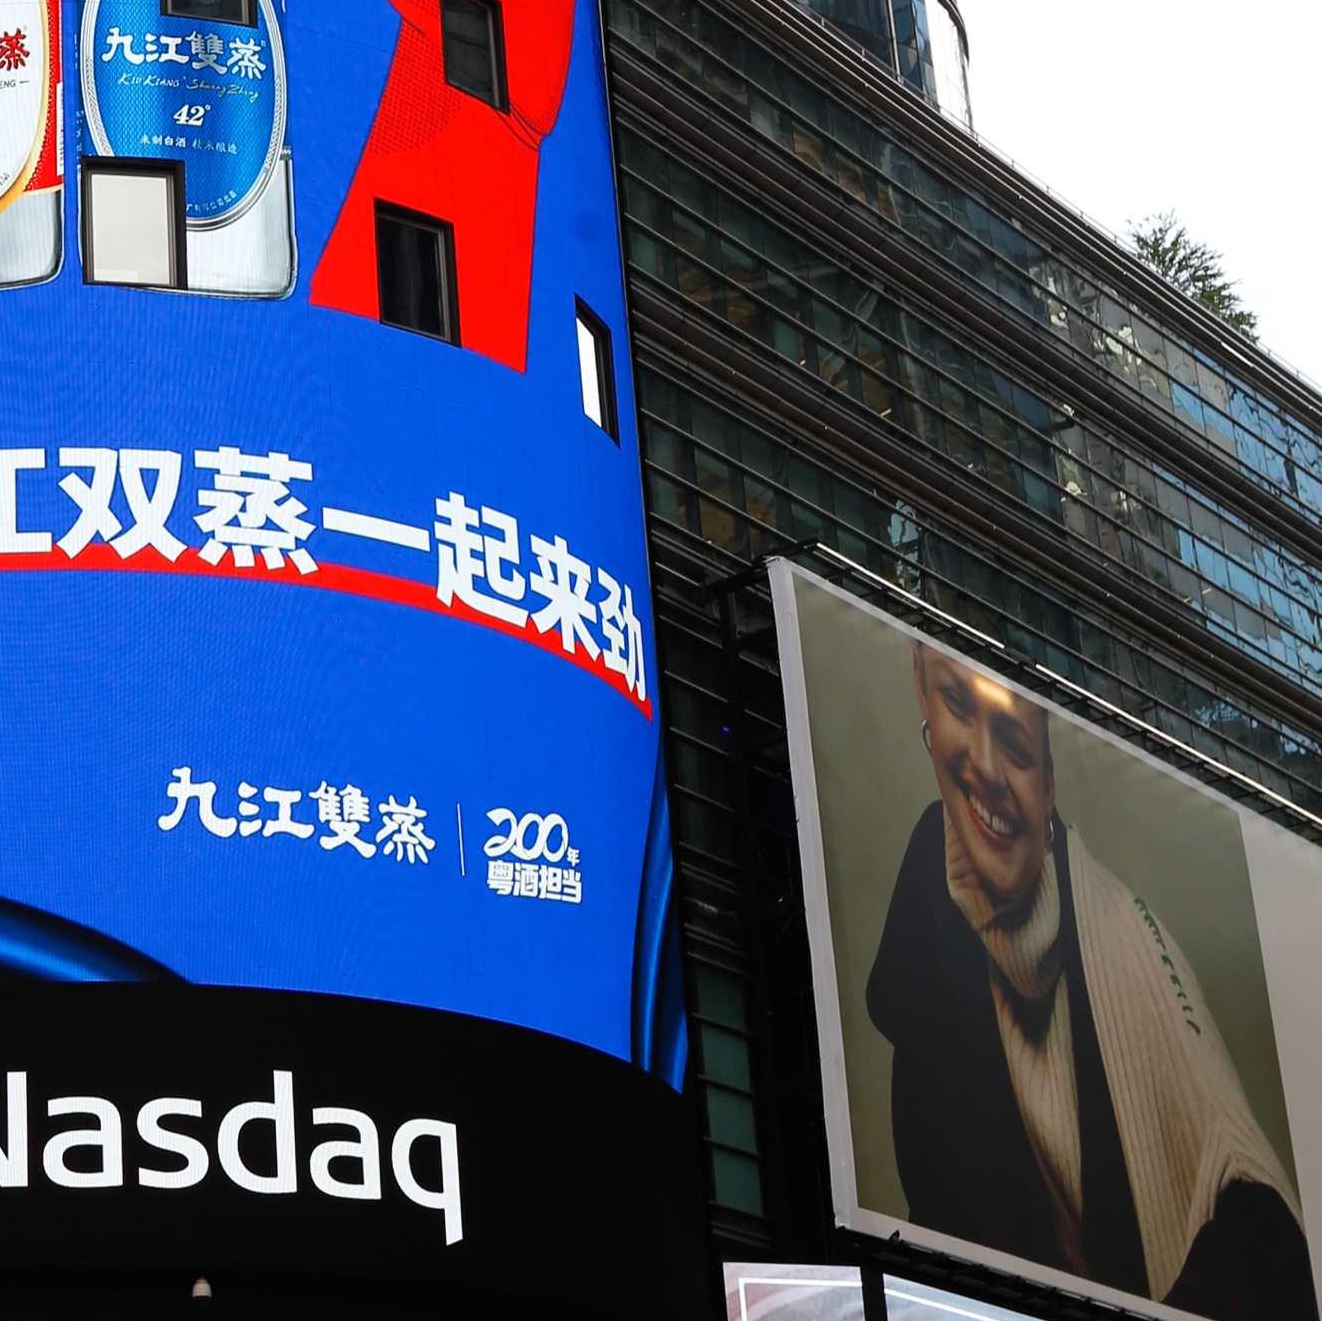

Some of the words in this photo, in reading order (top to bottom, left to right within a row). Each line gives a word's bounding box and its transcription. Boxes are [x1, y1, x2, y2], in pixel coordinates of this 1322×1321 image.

[101, 27, 267, 80] 九江雙蒸
[157, 766, 436, 864] 九江雙蒸
[486, 859, 583, 904] 粤酒担当
